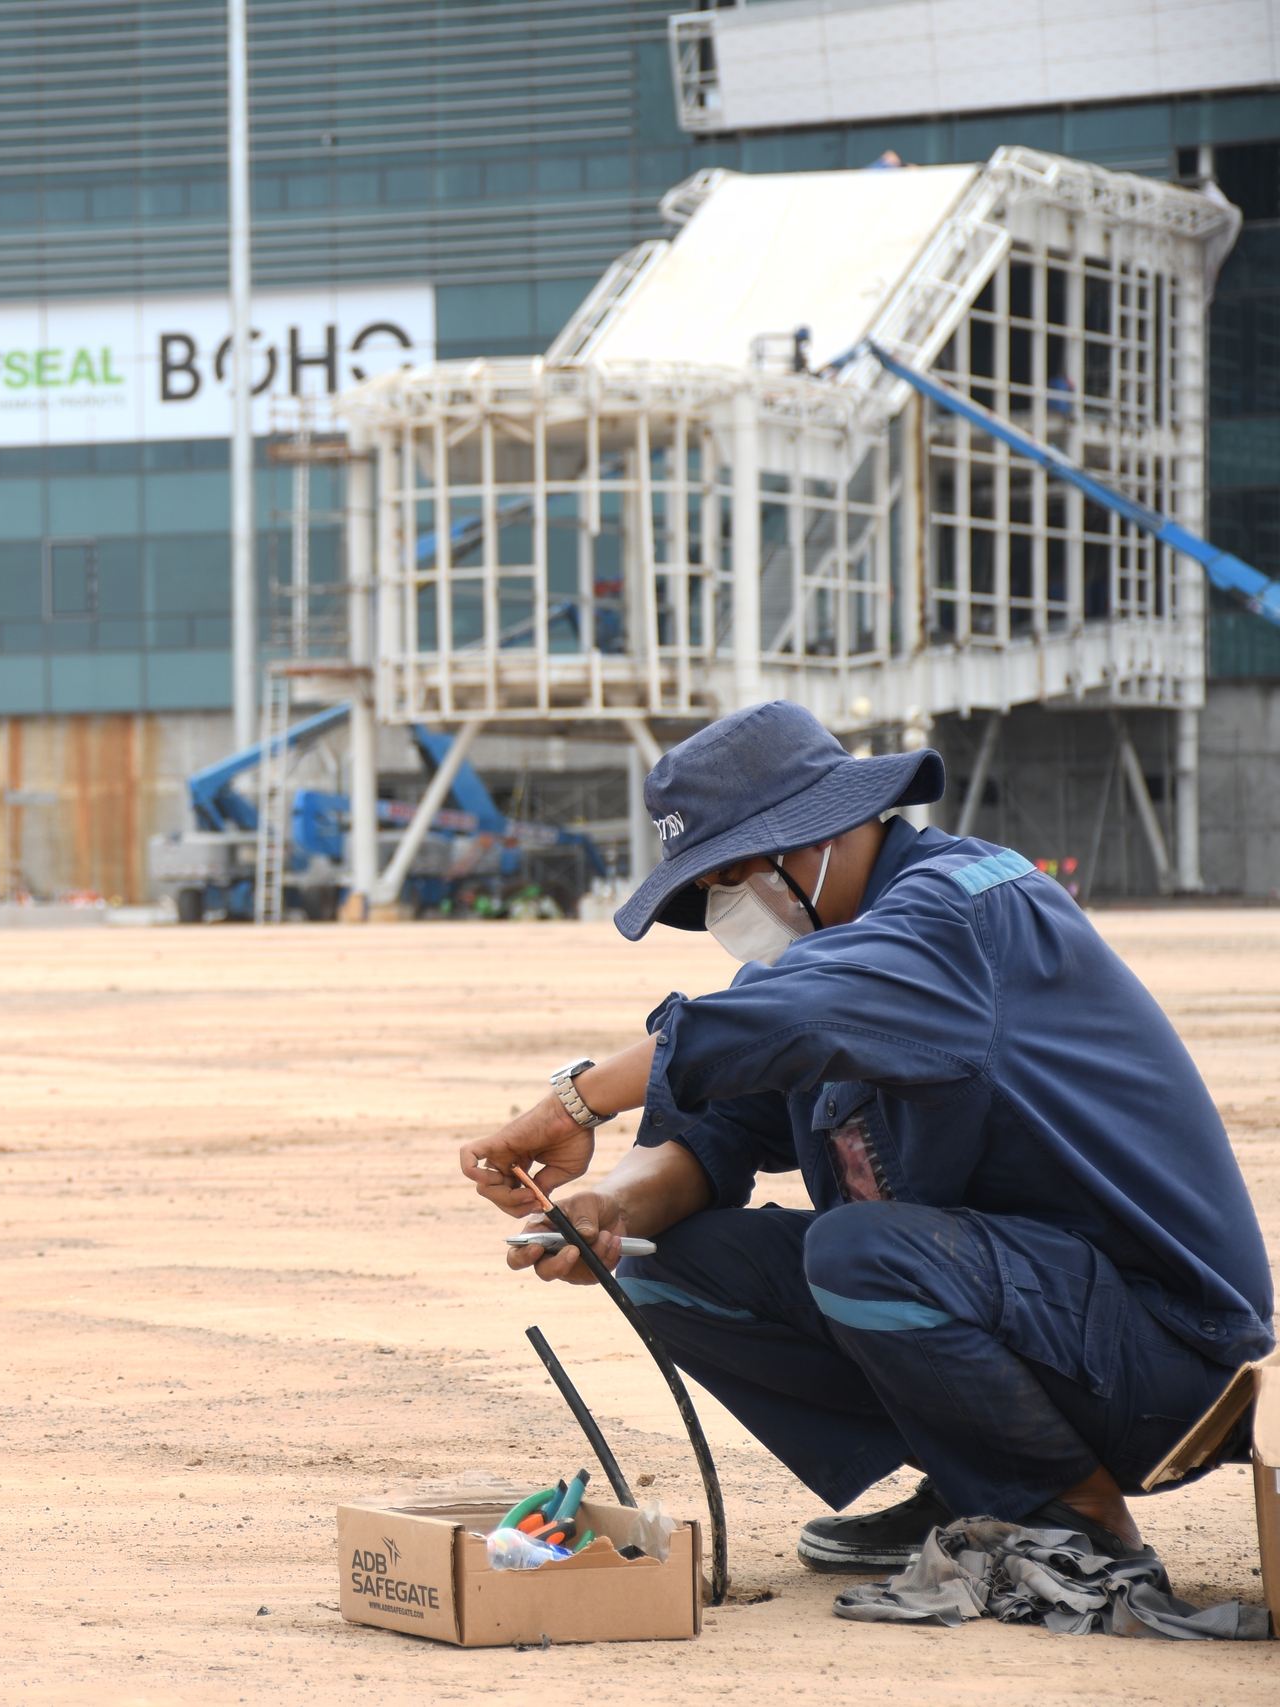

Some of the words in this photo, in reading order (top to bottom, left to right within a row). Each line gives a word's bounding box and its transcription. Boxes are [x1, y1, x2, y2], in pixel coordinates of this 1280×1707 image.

[161, 322, 412, 399] BOHO
[351, 1549, 387, 1575] ADB
[351, 1572, 440, 1609] SAFEGATE
[369, 1601, 425, 1619] WWW.ADBSAFEGATE.COM
